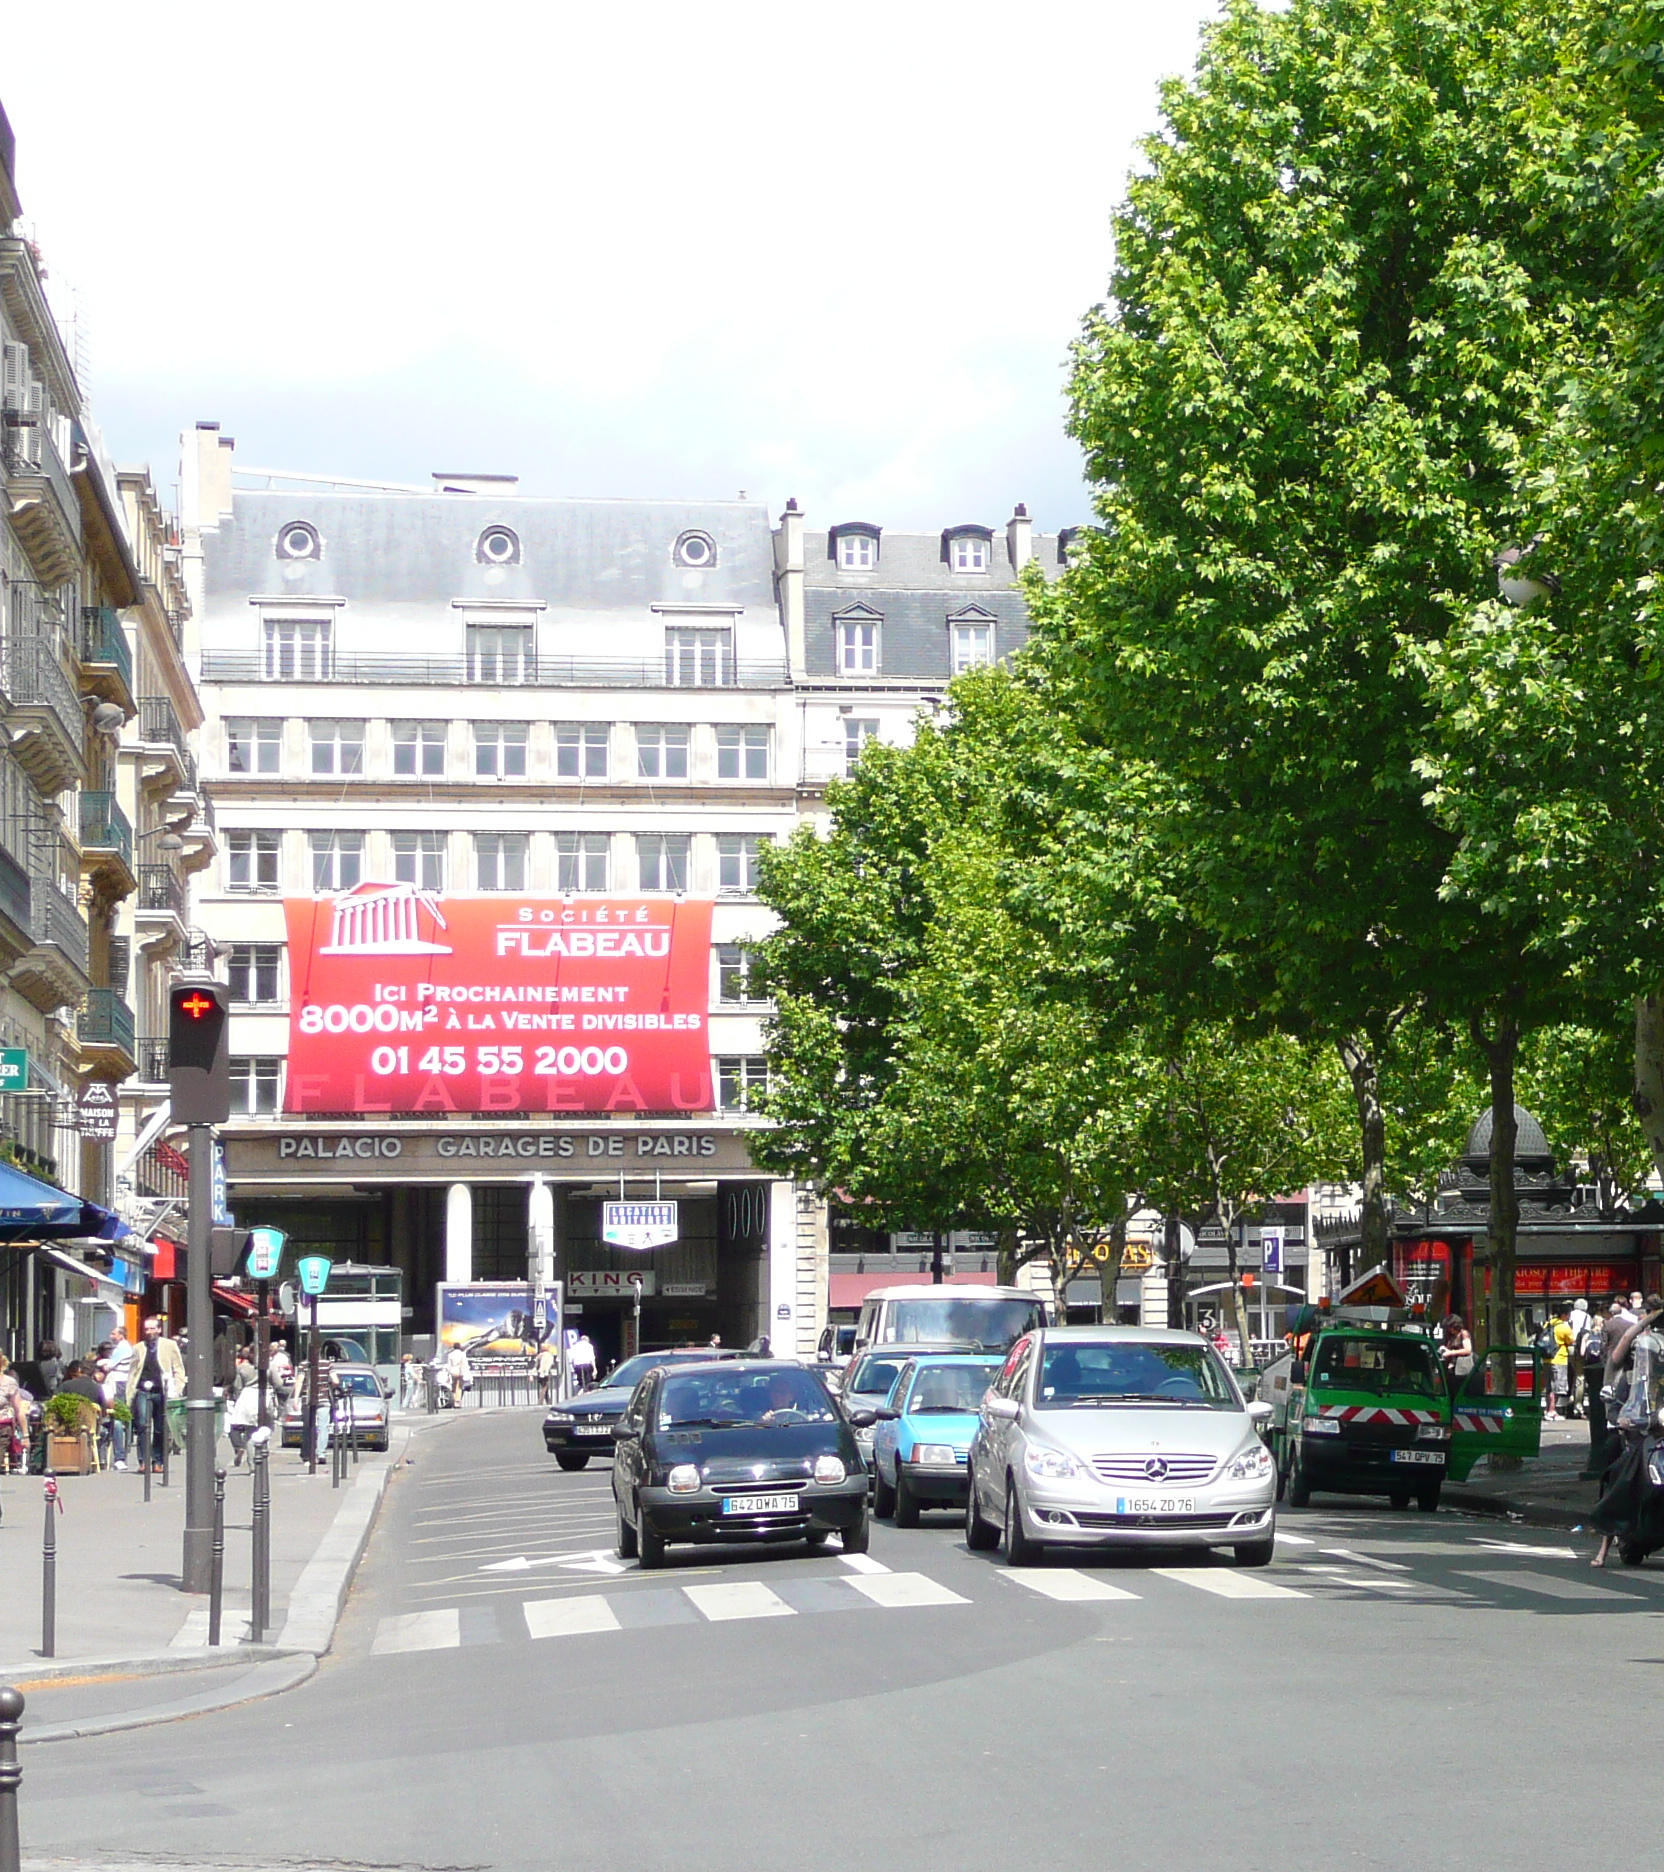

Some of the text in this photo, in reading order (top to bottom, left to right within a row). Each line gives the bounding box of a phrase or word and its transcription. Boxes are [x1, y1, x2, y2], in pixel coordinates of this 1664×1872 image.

[518, 906, 649, 923] SOCIÉTÉ
[497, 932, 669, 957] FLABEAU
[375, 983, 629, 1002] ICI PROCHAINEMENT
[467, 1014, 495, 1029] LA
[501, 1012, 574, 1030] VENTE
[582, 1014, 701, 1030] DIVISIBLES
[372, 1046, 628, 1075] 01 45 55 2000
[290, 1073, 713, 1111] FLABEAU
[279, 1135, 717, 1158] PALACIO GARAGES DE PARIS
[1264, 1240, 1273, 1263] P
[570, 1272, 643, 1285] KING
[781, 1496, 796, 1508] 75
[1128, 1499, 1192, 1511] 1654 ZD 76
